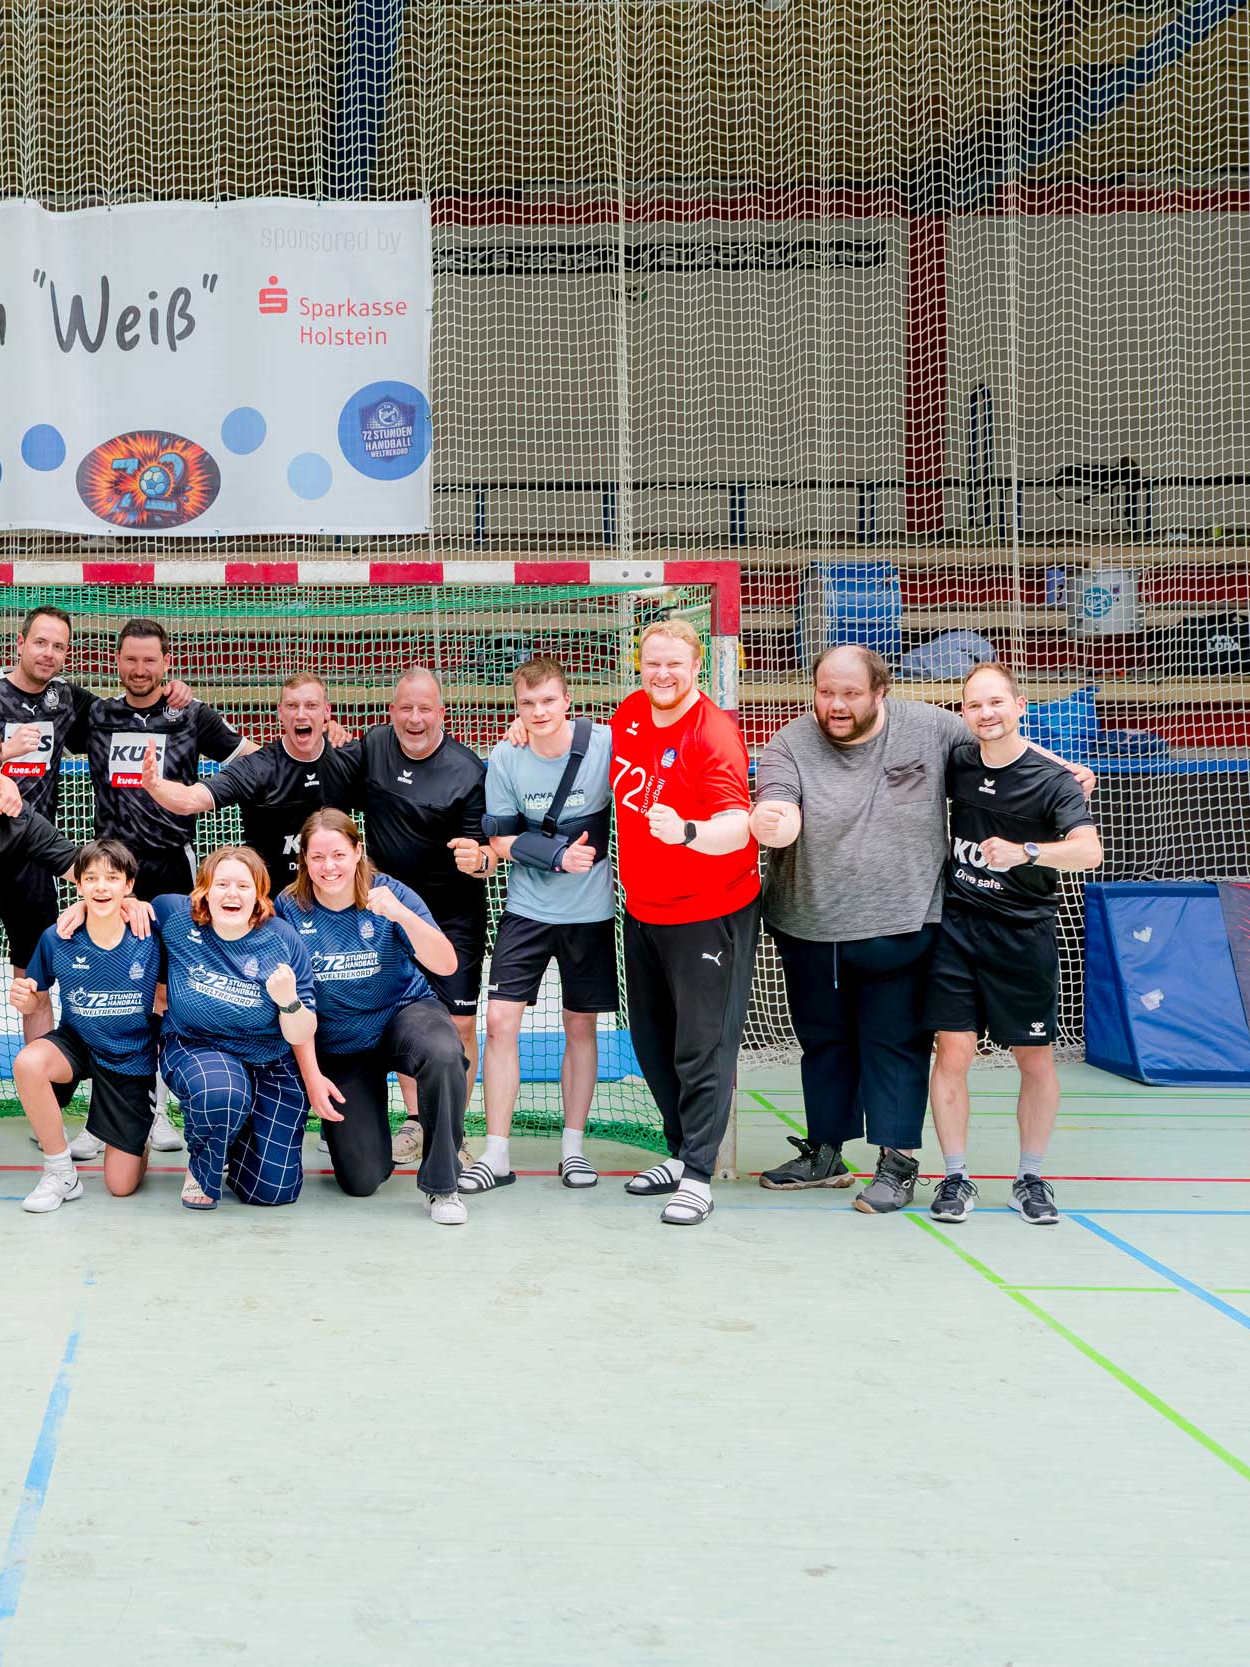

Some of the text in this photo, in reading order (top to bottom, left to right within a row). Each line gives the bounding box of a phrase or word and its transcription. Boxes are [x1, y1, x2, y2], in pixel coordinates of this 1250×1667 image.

[261, 225, 402, 255] sponsored by
[32, 268, 219, 354] "Weiß"
[299, 297, 408, 321] Sparkasse
[300, 325, 387, 346] Holstein
[361, 426, 413, 441] 72 STUNDEN
[365, 437, 412, 451] HANDBALL
[7, 764, 41, 775] kues.de
[116, 775, 143, 785] kues.
[613, 755, 647, 812] 72
[640, 775, 655, 814] Stunden
[652, 778, 666, 805] dball
[323, 955, 346, 971] 72
[345, 951, 378, 962] STUNDEN
[203, 972, 229, 990] 72
[319, 969, 372, 980] WELTREKORD
[86, 992, 109, 1007] 72
[109, 992, 143, 1000] STUNDEN
[198, 984, 252, 1006] WELTREKORD
[81, 1007, 134, 1016] WELTREKORD
